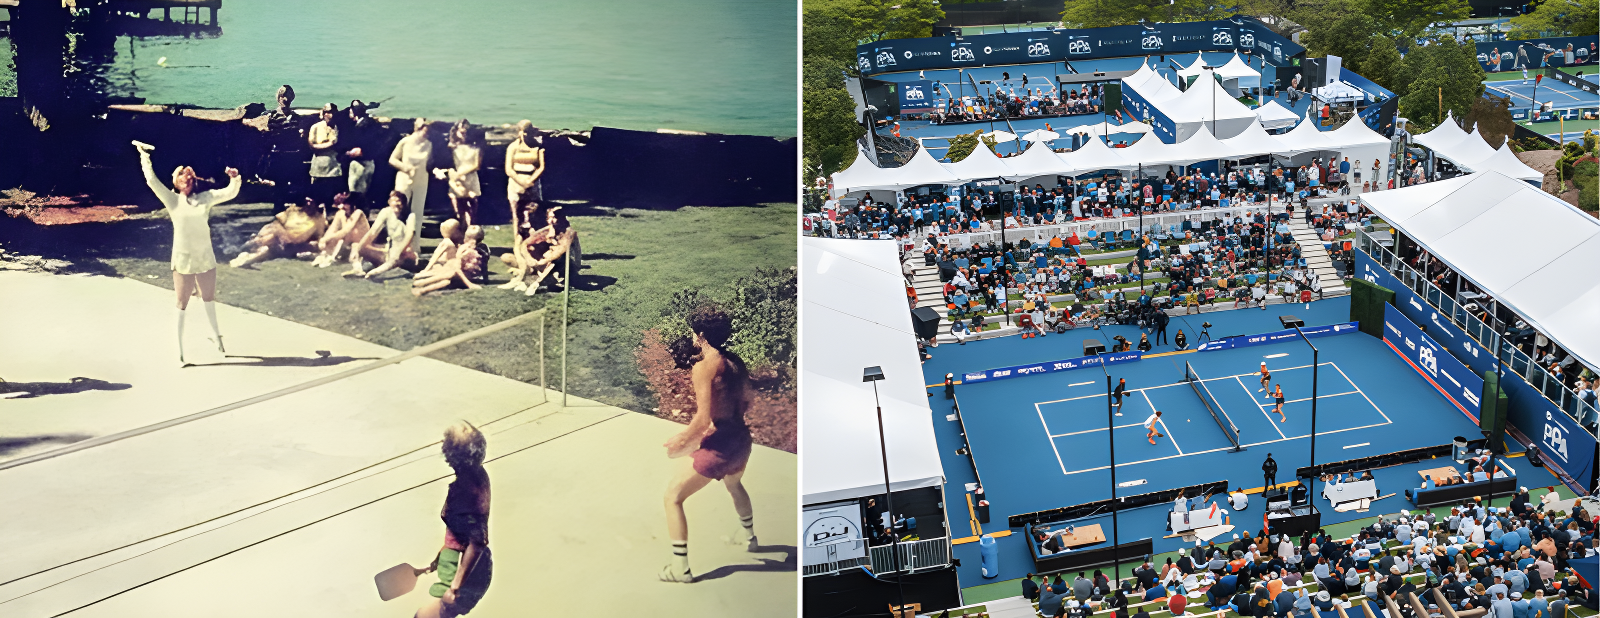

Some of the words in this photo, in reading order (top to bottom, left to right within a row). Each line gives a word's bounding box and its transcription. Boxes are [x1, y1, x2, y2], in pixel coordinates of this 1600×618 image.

[952, 47, 975, 60] PPA
[1028, 42, 1050, 56] PPA
[1069, 40, 1091, 54] PPA
[1420, 346, 1438, 375] PPA
[1544, 422, 1568, 460] PPA
[813, 526, 849, 542] DJ
